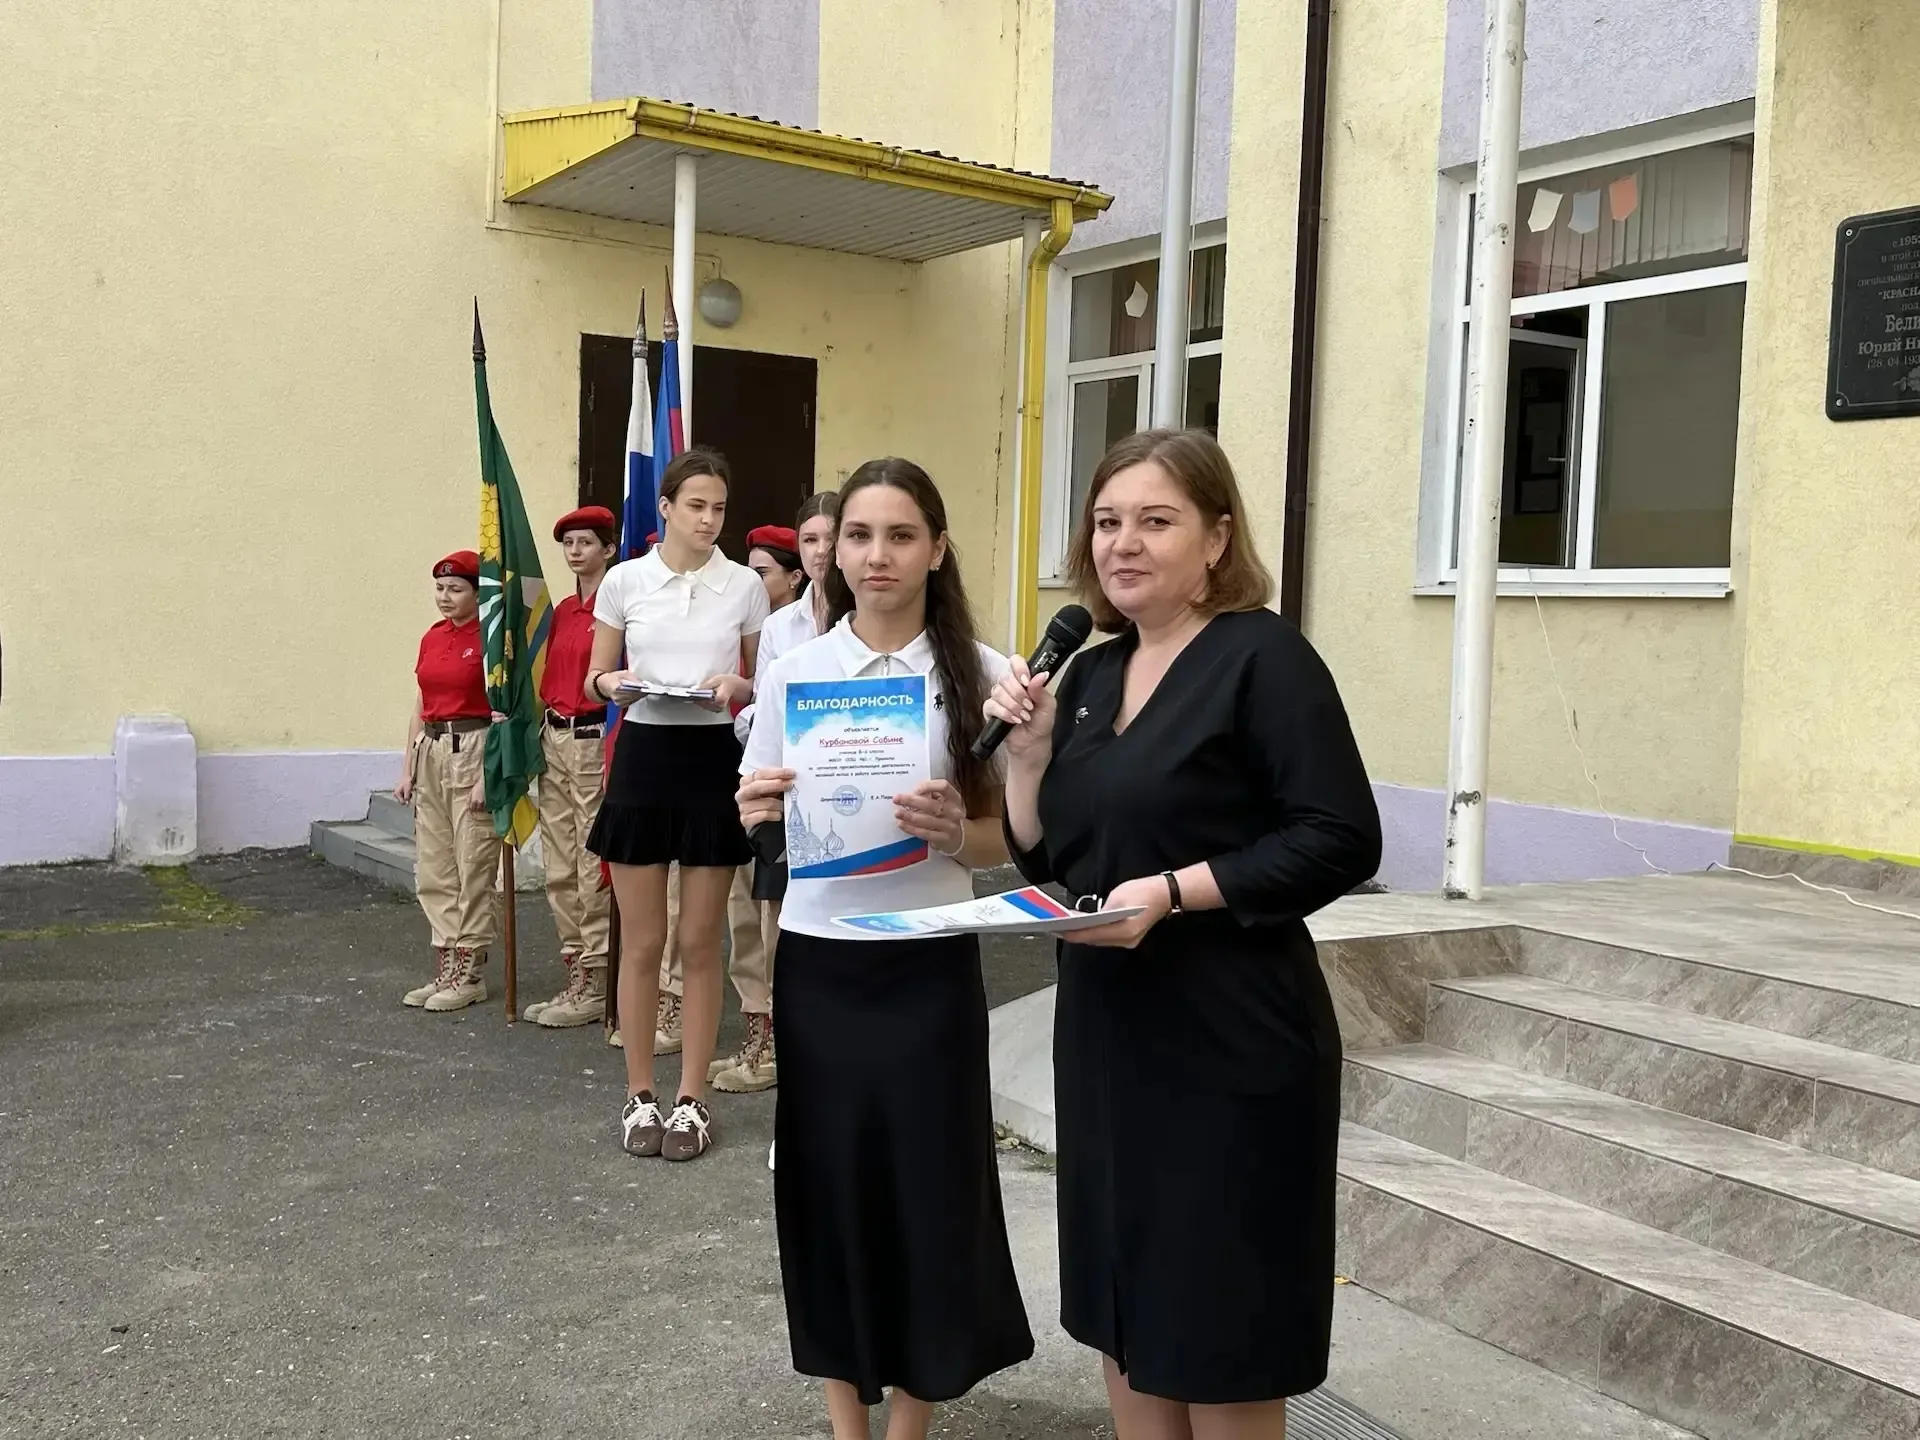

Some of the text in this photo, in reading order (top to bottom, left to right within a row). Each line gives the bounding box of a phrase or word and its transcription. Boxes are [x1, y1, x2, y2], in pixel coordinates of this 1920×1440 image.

[1885, 314, 1920, 333] Бели
[1858, 337, 1902, 357] Юрий
[797, 694, 914, 711] БЛАГОДАРНОСТЬ
